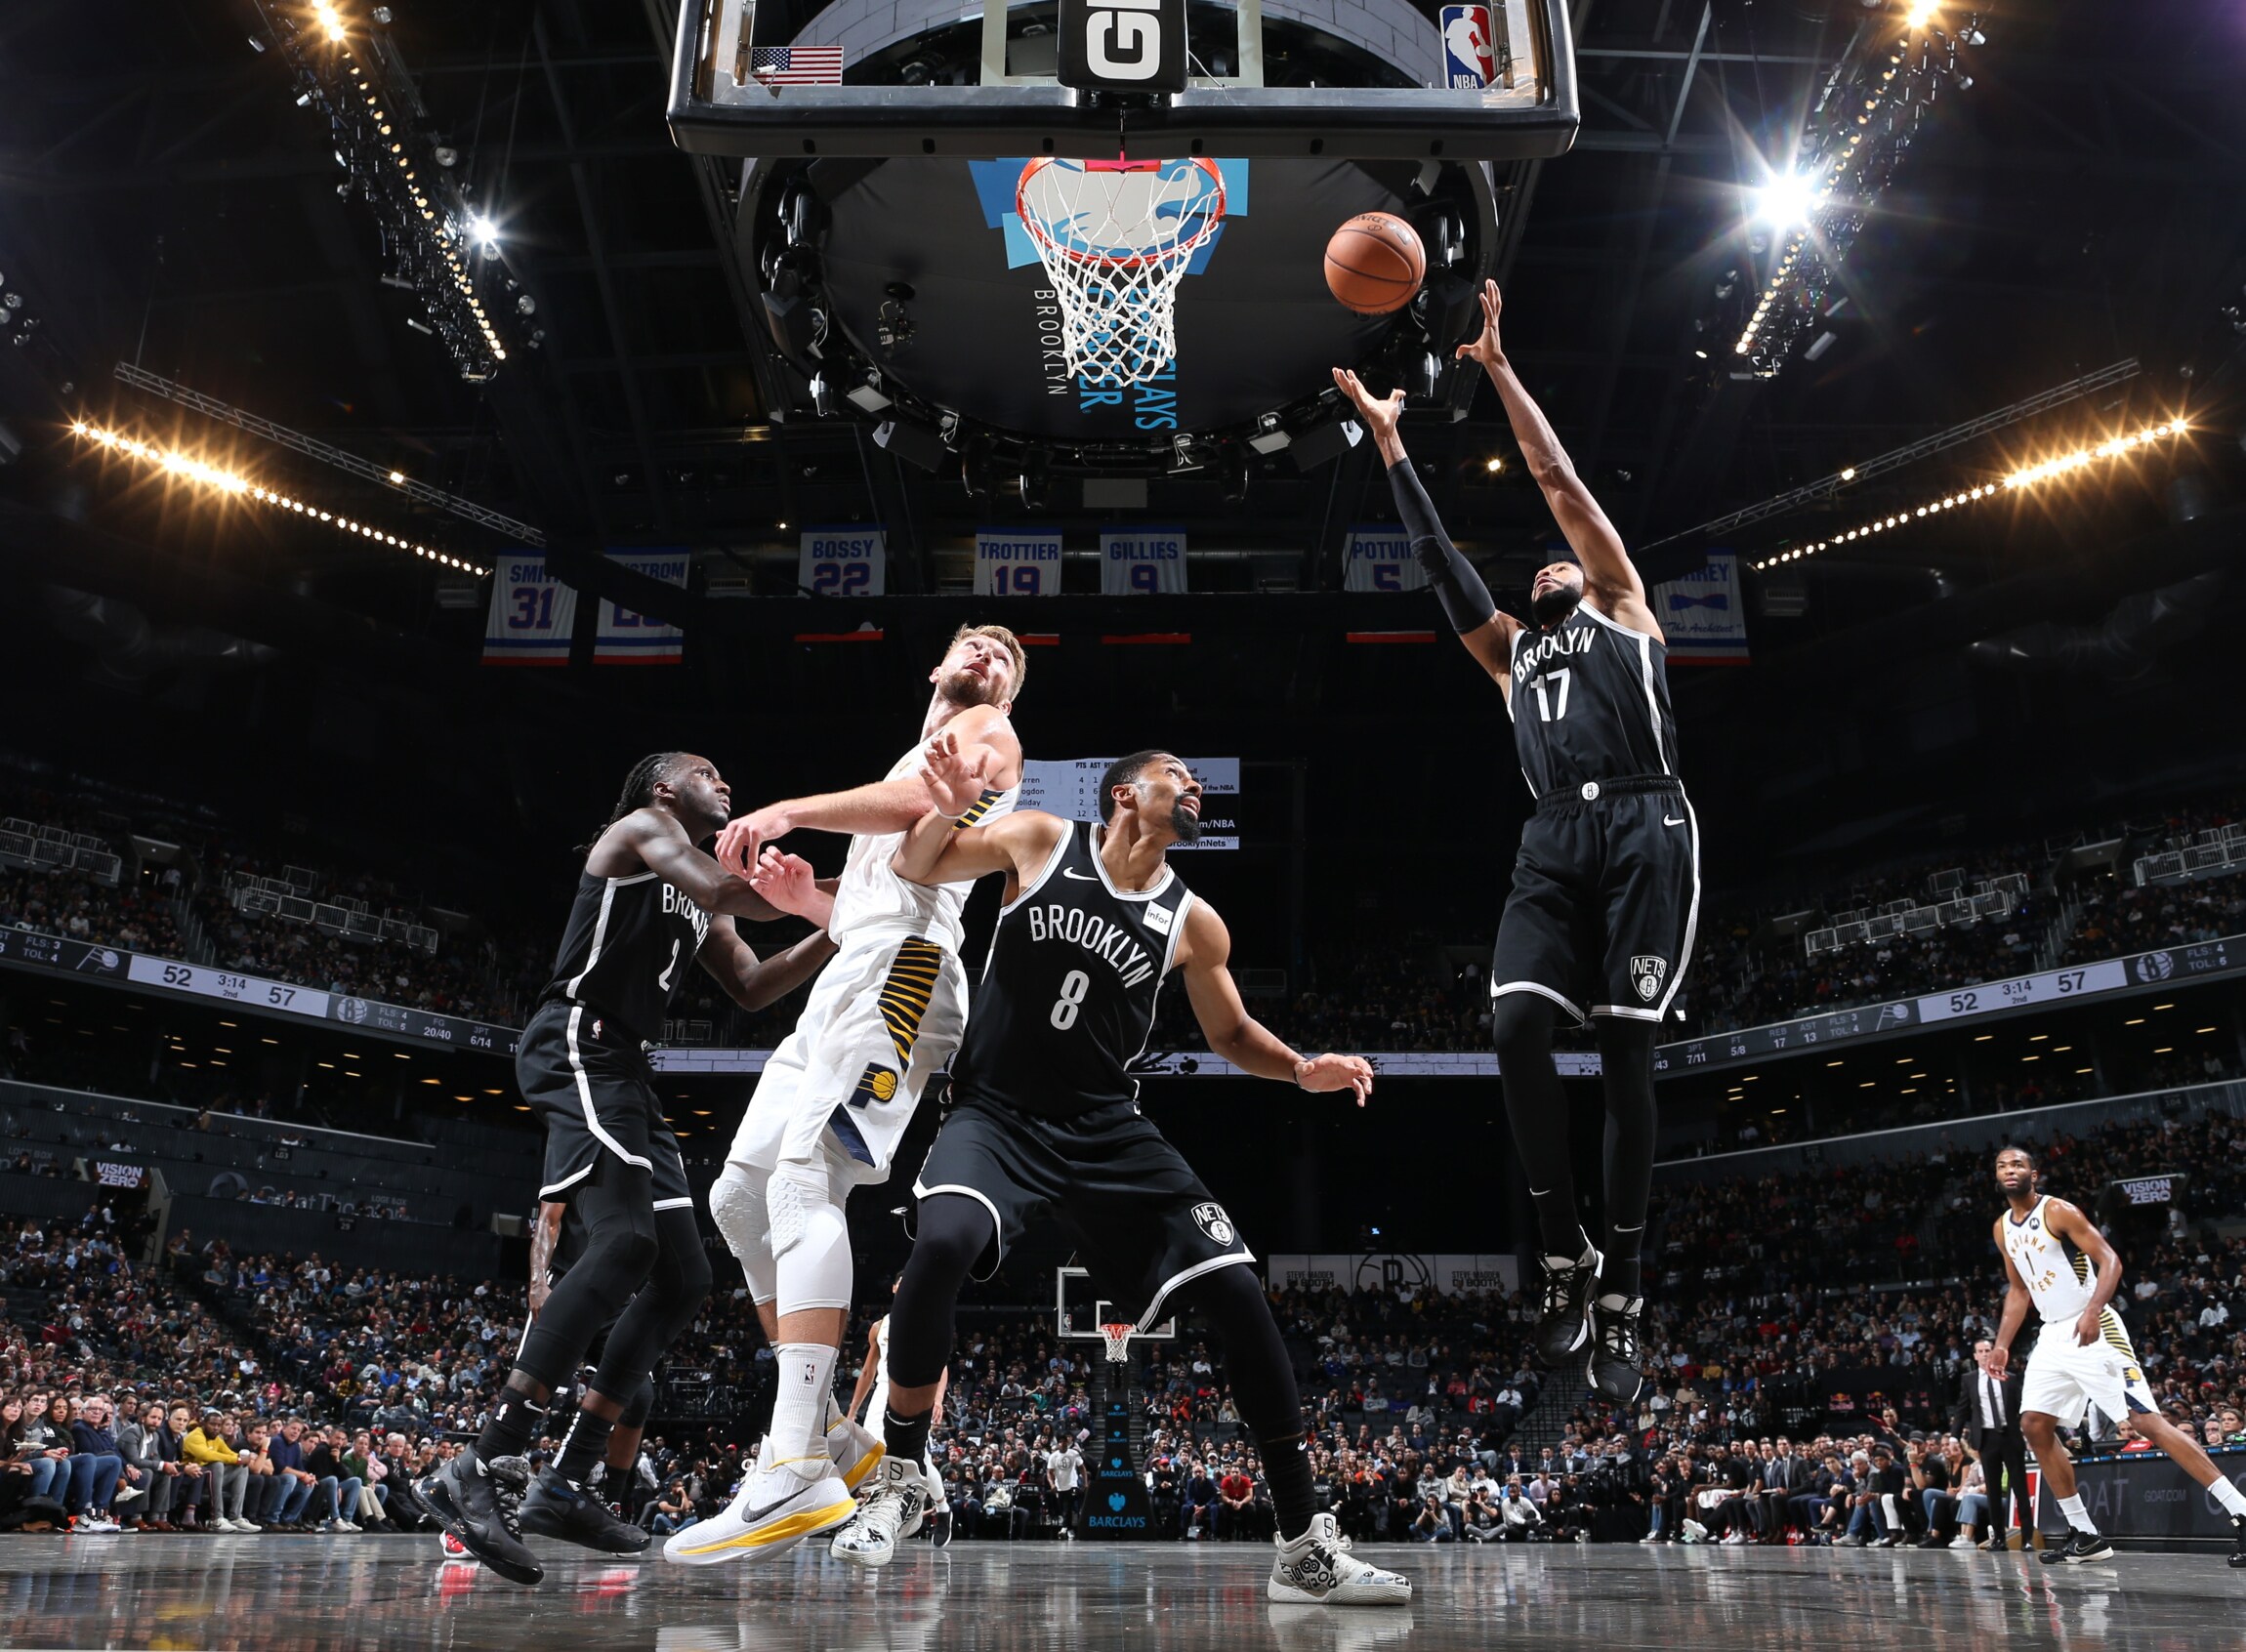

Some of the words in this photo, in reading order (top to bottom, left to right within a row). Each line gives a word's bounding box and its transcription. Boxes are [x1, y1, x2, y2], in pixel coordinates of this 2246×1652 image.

[1453, 74, 1478, 89] NBA
[1034, 289, 1068, 394] BROOKLYN
[812, 539, 875, 558] BOSSY
[979, 542, 1059, 560] TROTTIER
[1109, 542, 1179, 560] GILLIES
[812, 562, 870, 596] 22
[995, 565, 1040, 595] 19
[508, 587, 555, 629] 31
[1530, 667, 1571, 722] 17
[1146, 909, 1169, 926] infor
[25, 936, 50, 948] FLS:
[53, 940, 61, 950] 3
[1028, 904, 1154, 988] BROOKLYN
[2217, 944, 2225, 953] 4
[22, 947, 48, 961] TOL:
[50, 953, 58, 963] 4
[1633, 958, 1665, 977] NETS
[162, 965, 192, 987] 52
[218, 974, 246, 990] 3:14
[2058, 971, 2086, 993] 57
[223, 989, 238, 999] 2nd
[2003, 979, 2032, 996] 3:14
[268, 986, 296, 1007] 57
[1050, 970, 1090, 1031] 8
[1950, 992, 1978, 1012] 52
[2012, 995, 2028, 1005] 2nd
[401, 1012, 407, 1020] 4
[423, 1026, 452, 1041] 20/40
[1804, 1032, 1817, 1044] 13
[470, 1035, 491, 1049] 6/14
[1773, 1038, 1786, 1049] 17
[1686, 1053, 1706, 1065] 7/11
[1730, 1046, 1746, 1056] 5/8
[97, 1162, 144, 1178] VISION
[99, 1174, 139, 1188] ZERO
[2122, 1178, 2172, 1194] VISION
[2130, 1189, 2172, 1205] ZERO
[1194, 1205, 1230, 1225] NETS
[2024, 1251, 2036, 1276] 1
[1467, 1278, 1500, 1287] BOOTH
[2054, 1478, 2130, 1517] OAT
[2143, 1488, 2187, 1504] GOAT.COM
[1089, 1515, 1145, 1528] BARCLAYS
